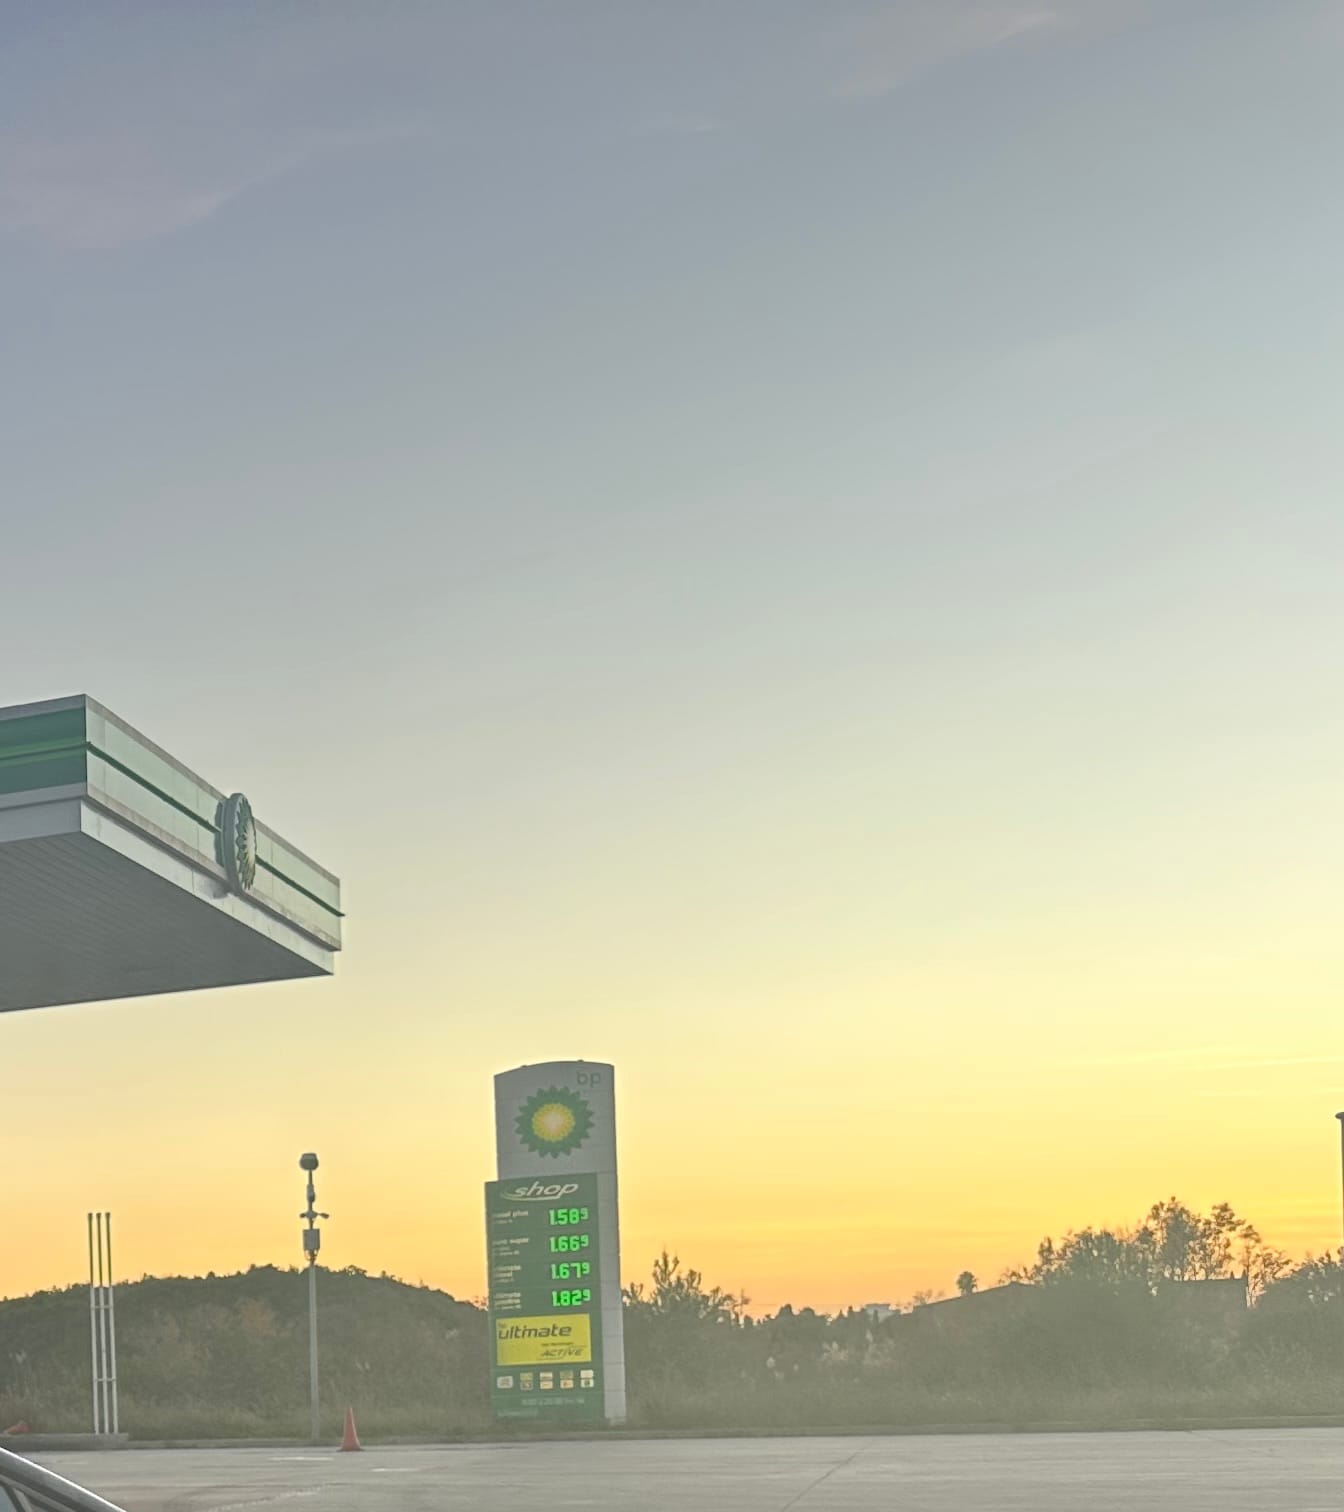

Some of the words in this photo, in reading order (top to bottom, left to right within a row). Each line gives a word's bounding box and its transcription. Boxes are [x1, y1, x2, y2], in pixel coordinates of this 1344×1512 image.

[514, 1180, 580, 1200] shop
[548, 1207, 589, 1226] 1.589
[549, 1234, 590, 1253] 1.669
[550, 1261, 591, 1280] 1.679
[551, 1288, 592, 1307] 1.829
[498, 1323, 572, 1340] ultimate
